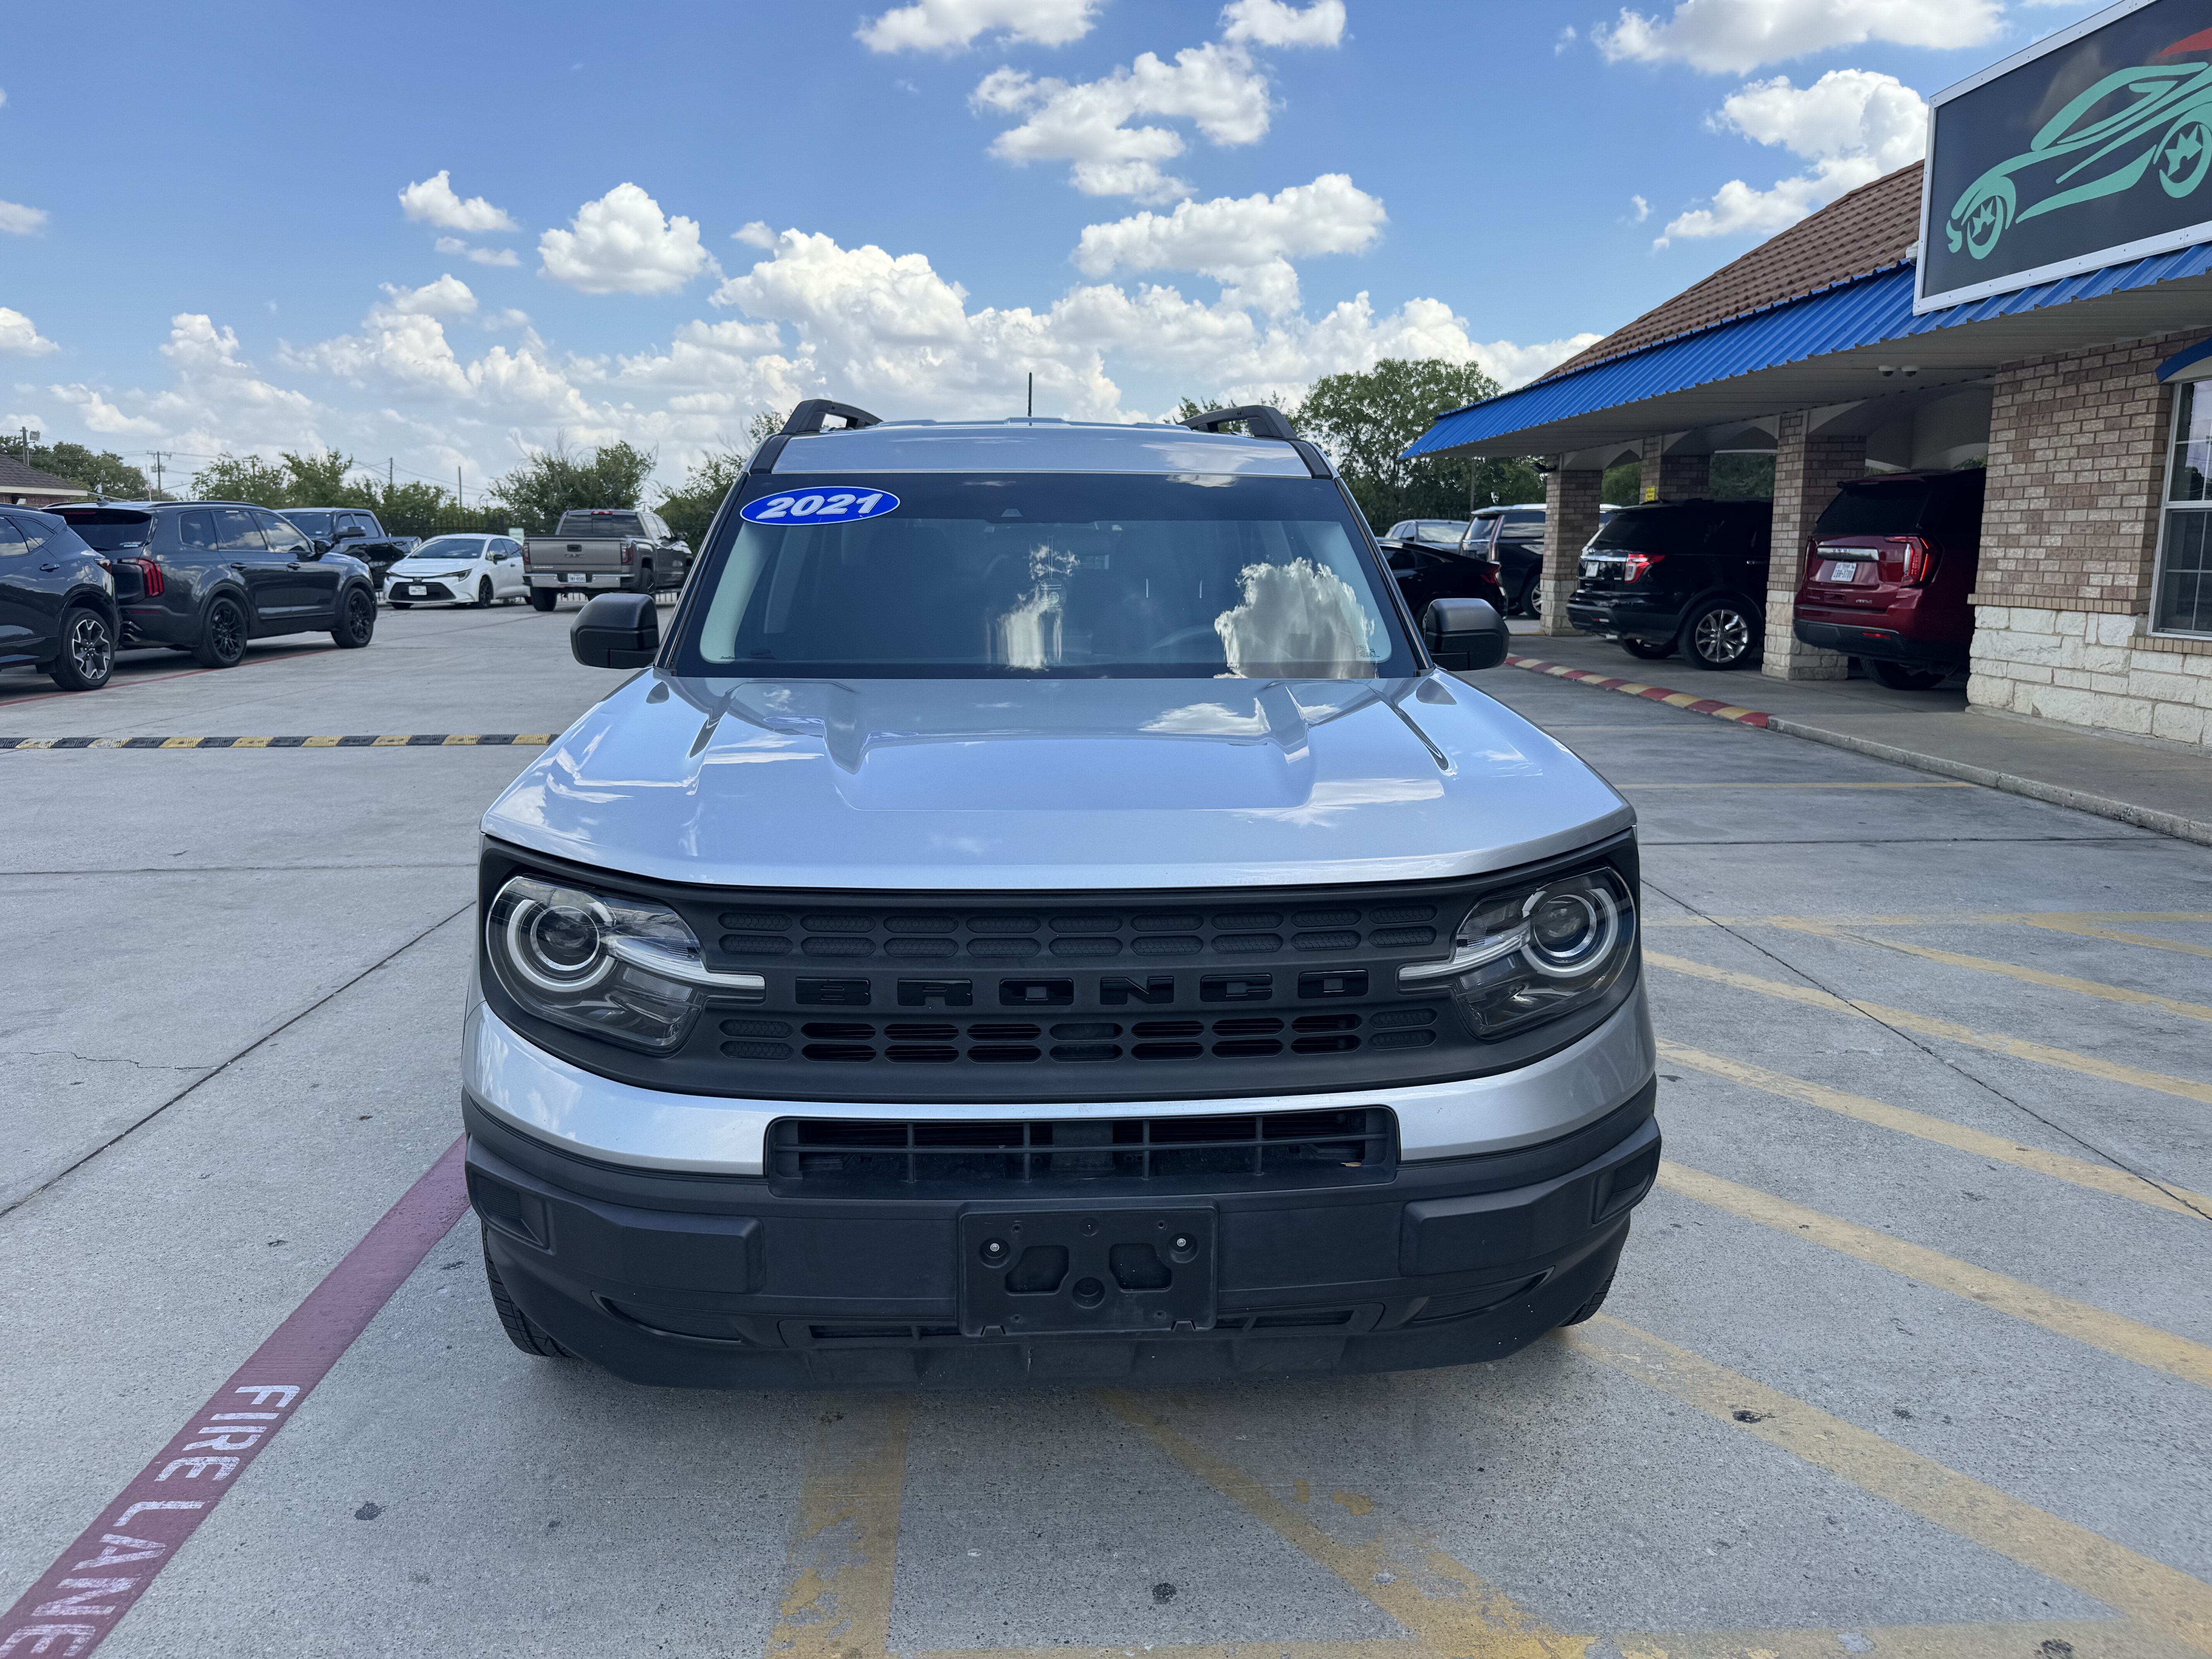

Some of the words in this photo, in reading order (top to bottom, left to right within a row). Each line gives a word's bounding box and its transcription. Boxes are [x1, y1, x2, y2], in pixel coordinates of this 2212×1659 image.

[756, 493, 883, 519] 2021
[795, 970, 1369, 1006] BRONCO
[154, 1385, 301, 1482] FIRE
[0, 1501, 206, 1657] LANE
